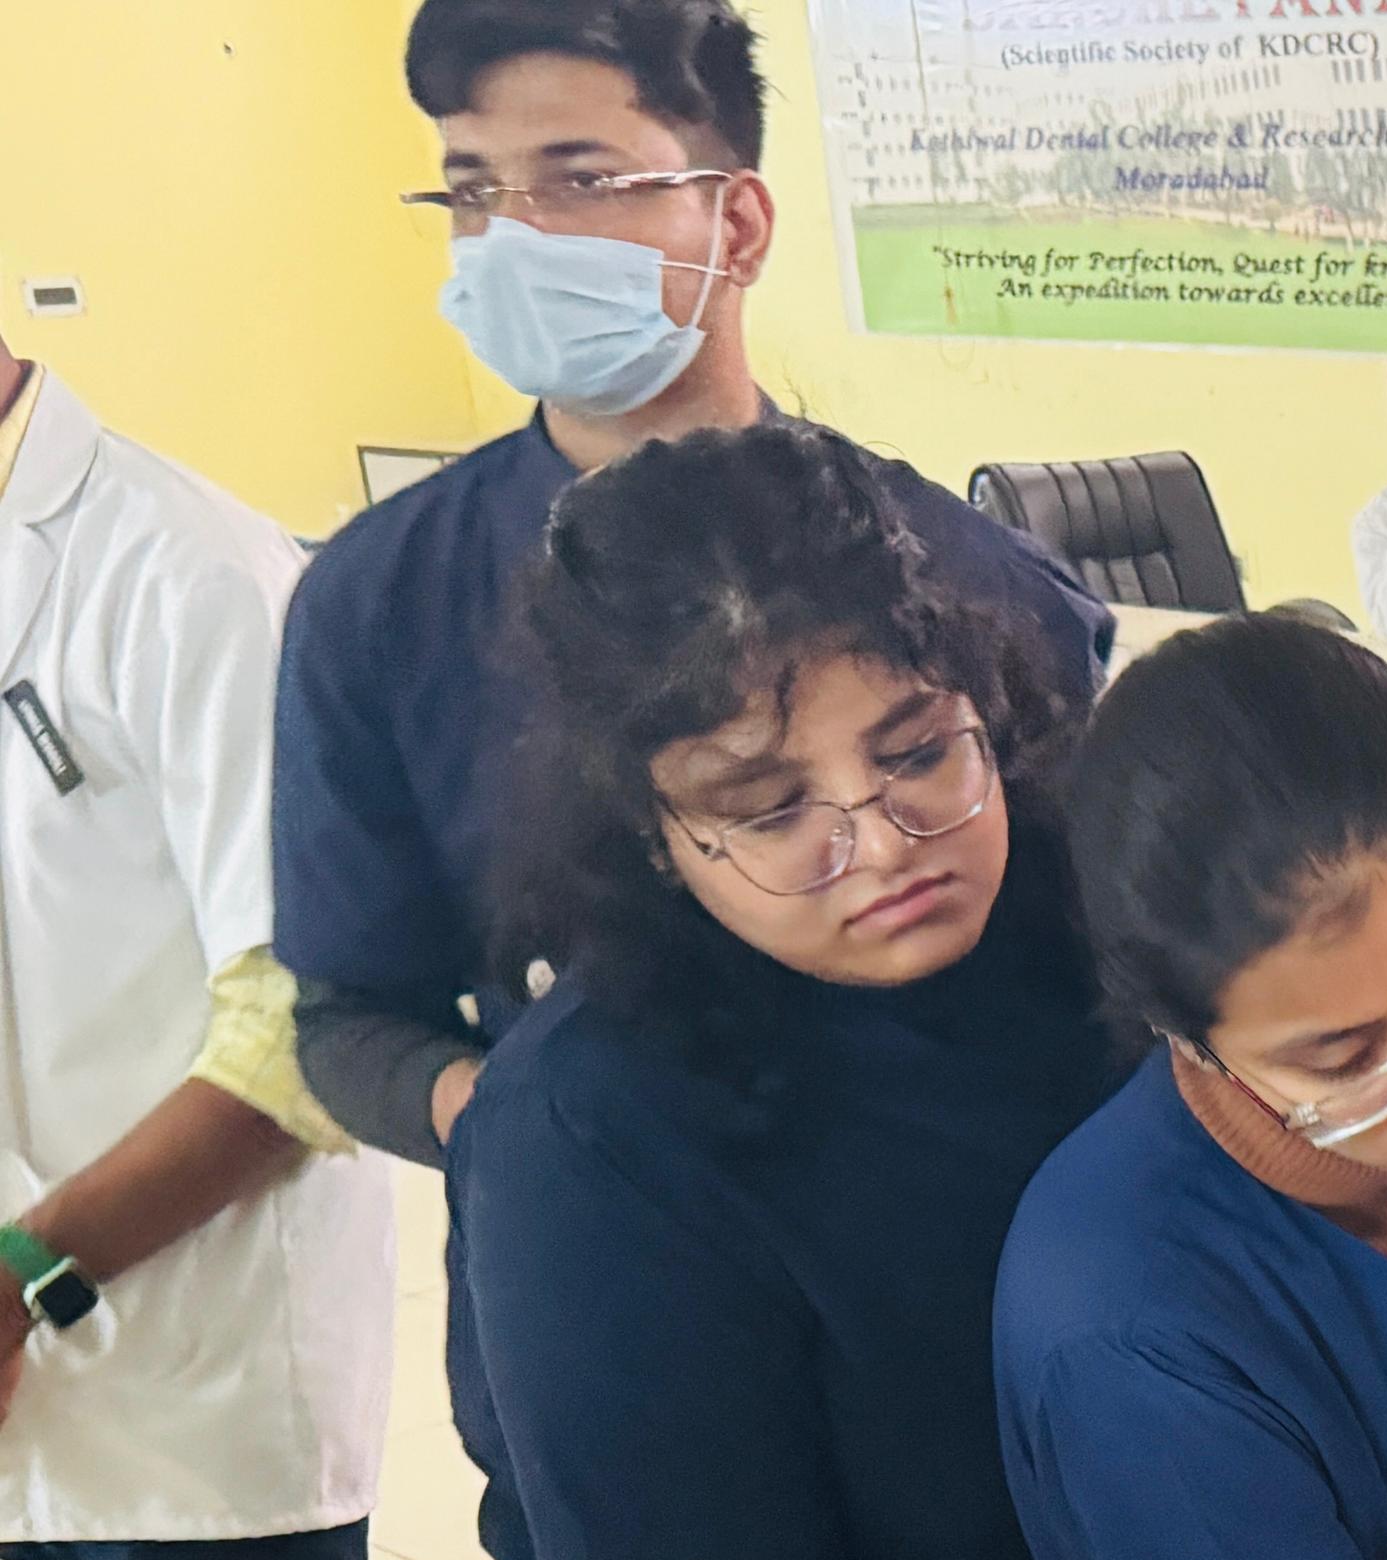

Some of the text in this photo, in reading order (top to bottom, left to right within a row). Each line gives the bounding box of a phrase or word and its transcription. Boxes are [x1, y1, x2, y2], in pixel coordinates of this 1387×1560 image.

[1000, 31, 1380, 70] (Scientific Society of KDCRC)
[1025, 125, 1110, 150] Dental
[1118, 123, 1217, 156] College
[1228, 123, 1249, 149] &
[1114, 165, 1269, 191] Moradabad
[933, 245, 1036, 277] "Striving
[1039, 248, 1079, 278] for
[1088, 249, 1223, 278] Perfection,
[1233, 252, 1305, 278] Quest
[1310, 251, 1356, 284] for
[996, 277, 1032, 298] An
[1041, 277, 1170, 305] expedition
[1178, 281, 1285, 305] towards
